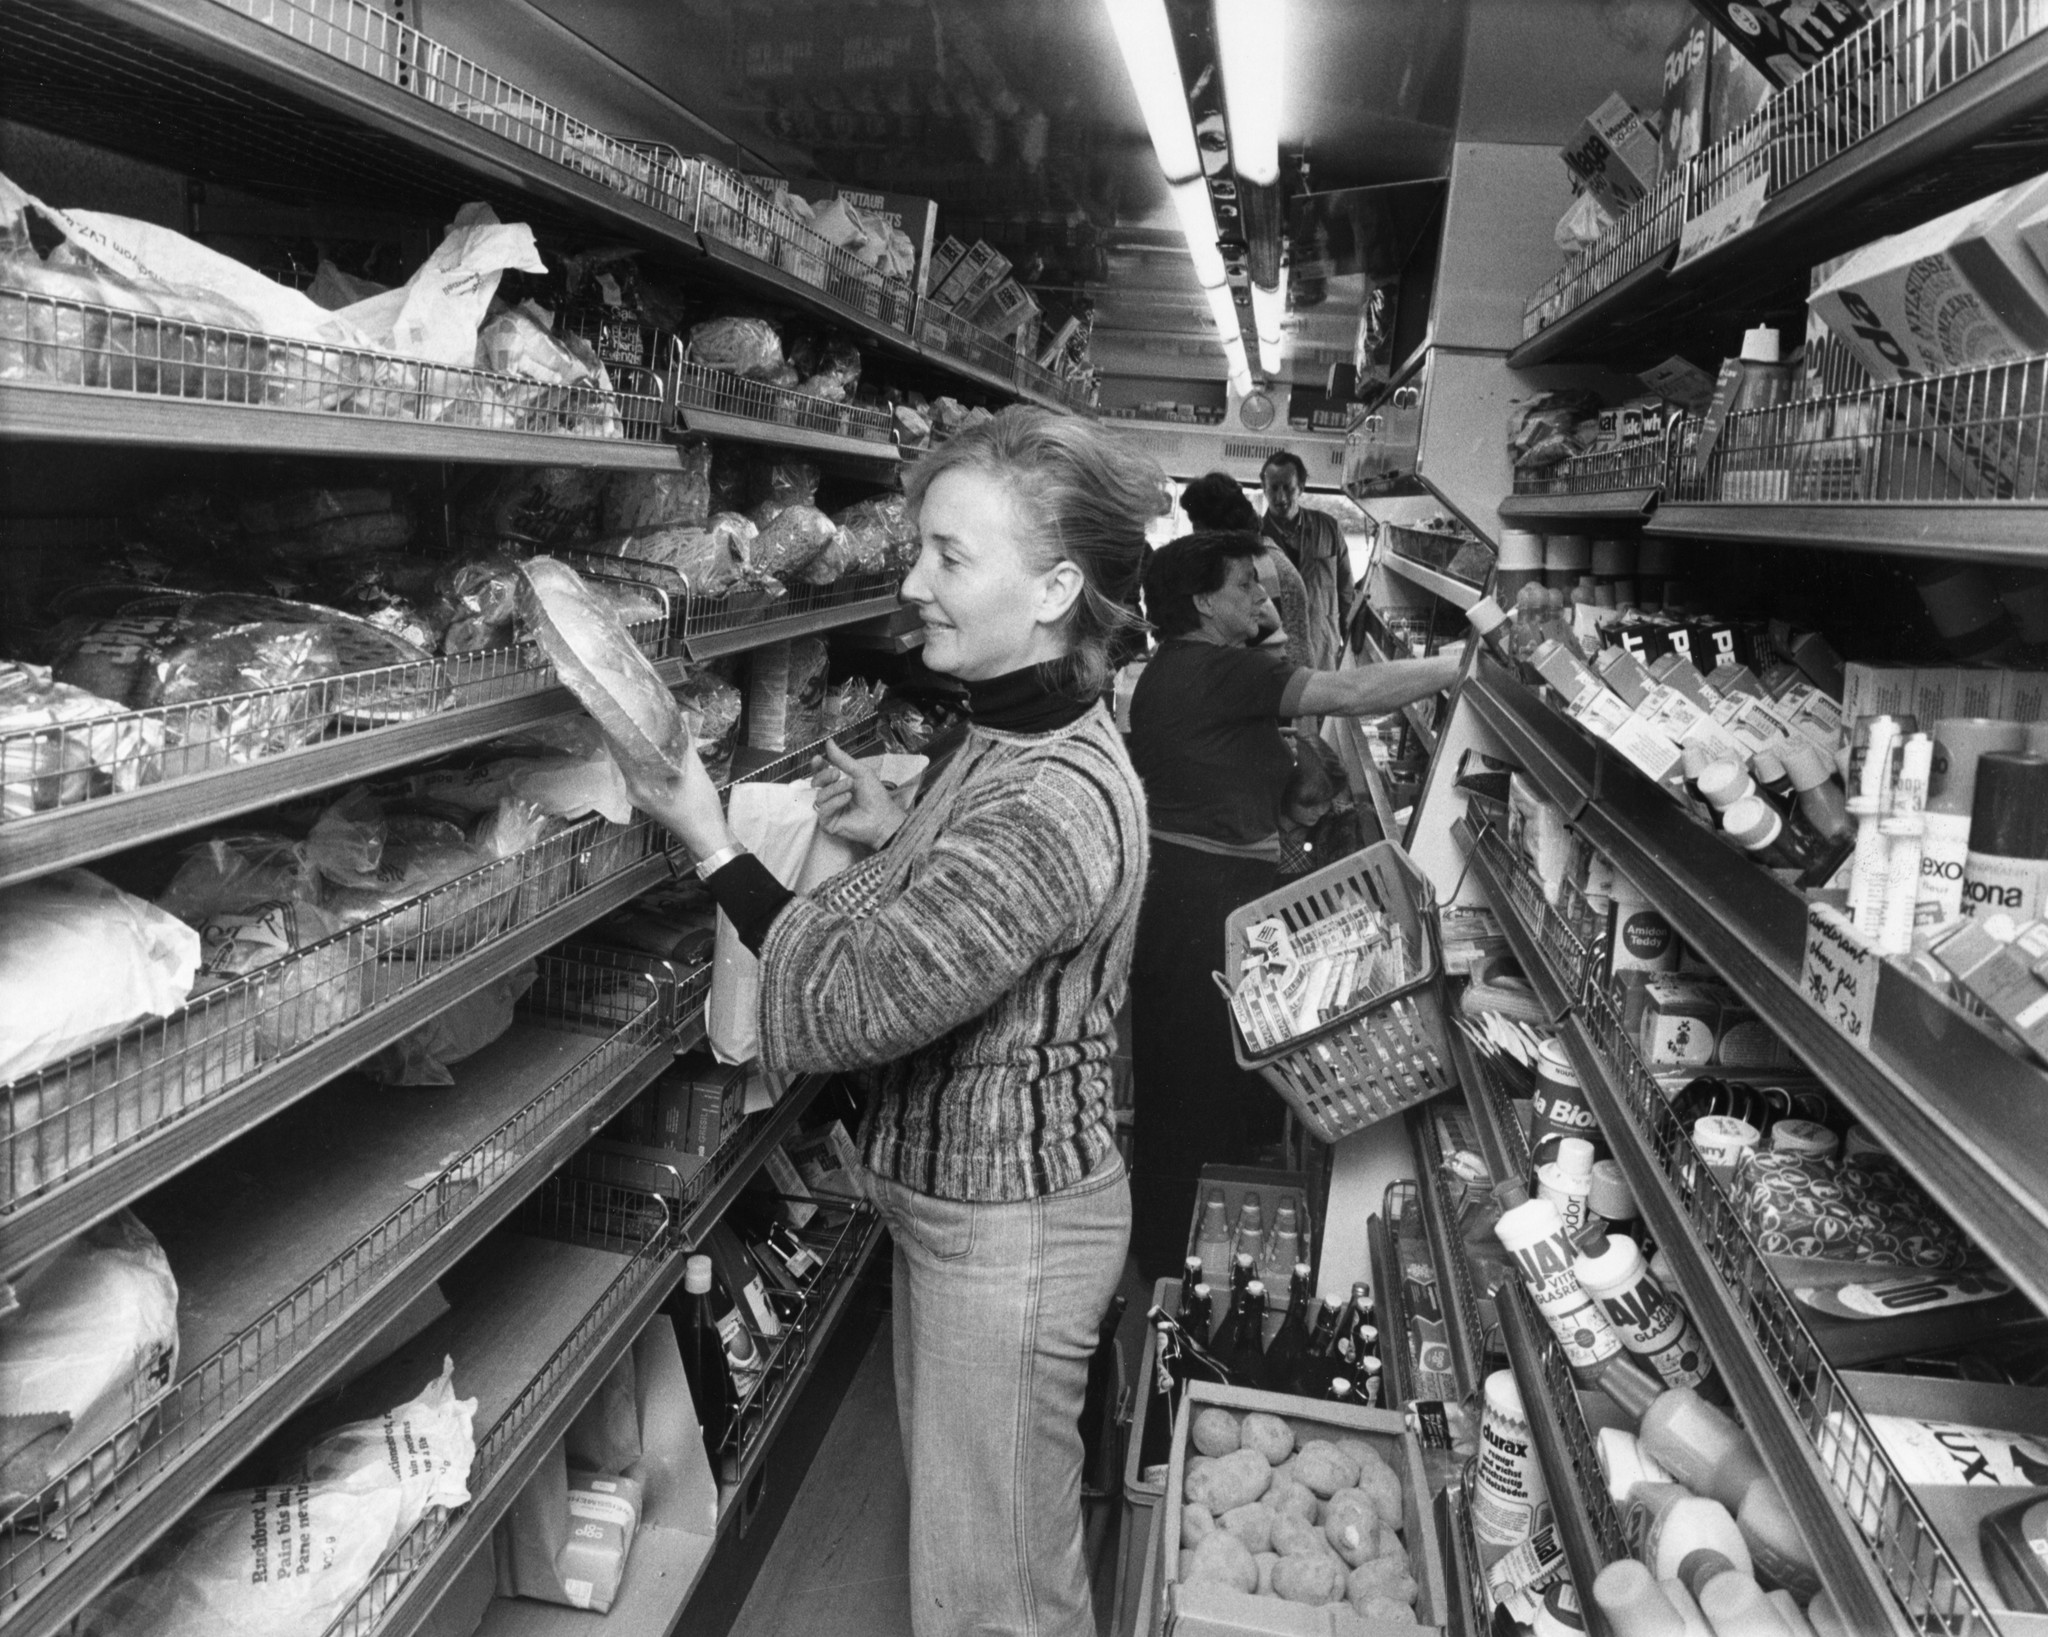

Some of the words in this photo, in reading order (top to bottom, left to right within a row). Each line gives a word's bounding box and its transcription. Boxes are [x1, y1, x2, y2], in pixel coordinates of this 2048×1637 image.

[838, 189, 884, 209] KENTAUR
[1257, 925, 1279, 940] HIT
[1627, 925, 1667, 935] Amidon
[1630, 934, 1662, 947] Teddy
[1483, 1423, 1528, 1458] durax
[277, 1511, 291, 1537] bis
[277, 1538, 291, 1582] Pain
[296, 1532, 310, 1577] Pane
